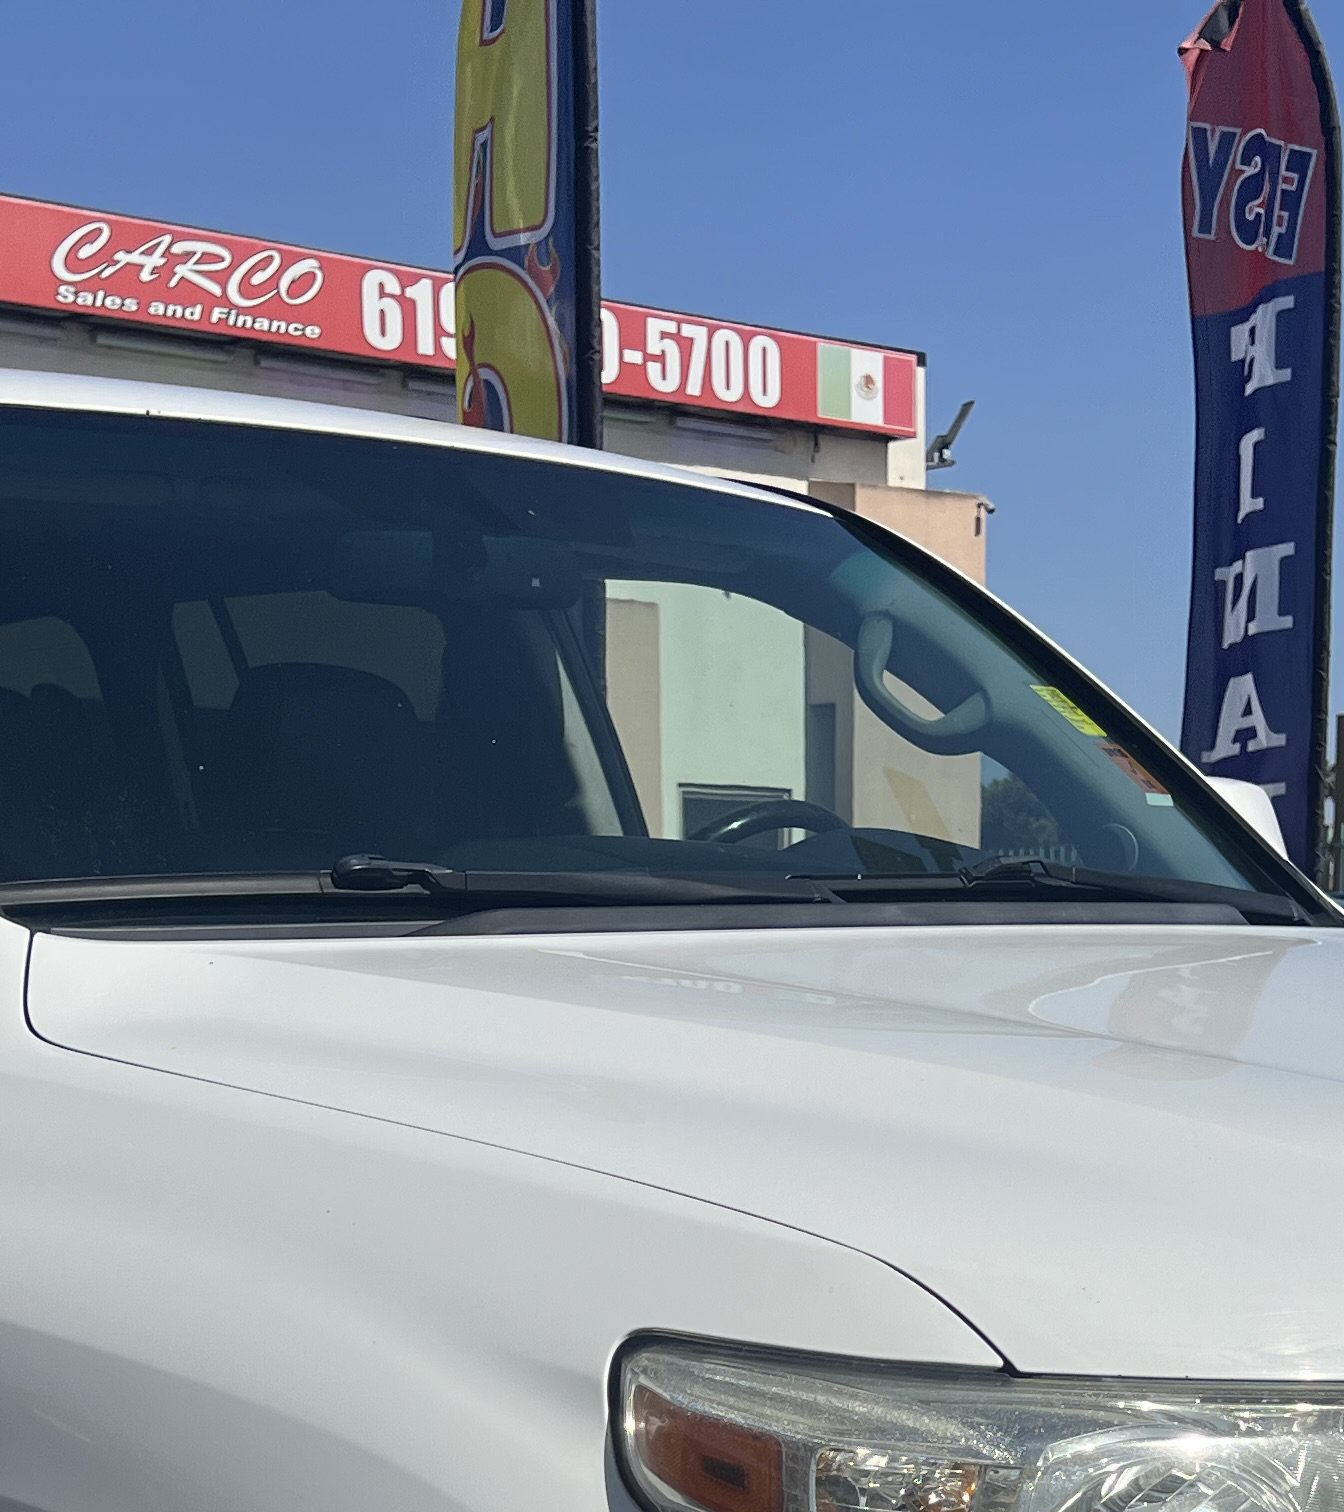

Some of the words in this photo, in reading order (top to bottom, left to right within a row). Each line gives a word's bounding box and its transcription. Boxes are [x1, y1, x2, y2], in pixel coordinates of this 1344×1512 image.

[50, 221, 324, 308] CARCO
[55, 284, 140, 312] Sales
[147, 300, 203, 322] and
[210, 307, 323, 339] Finance
